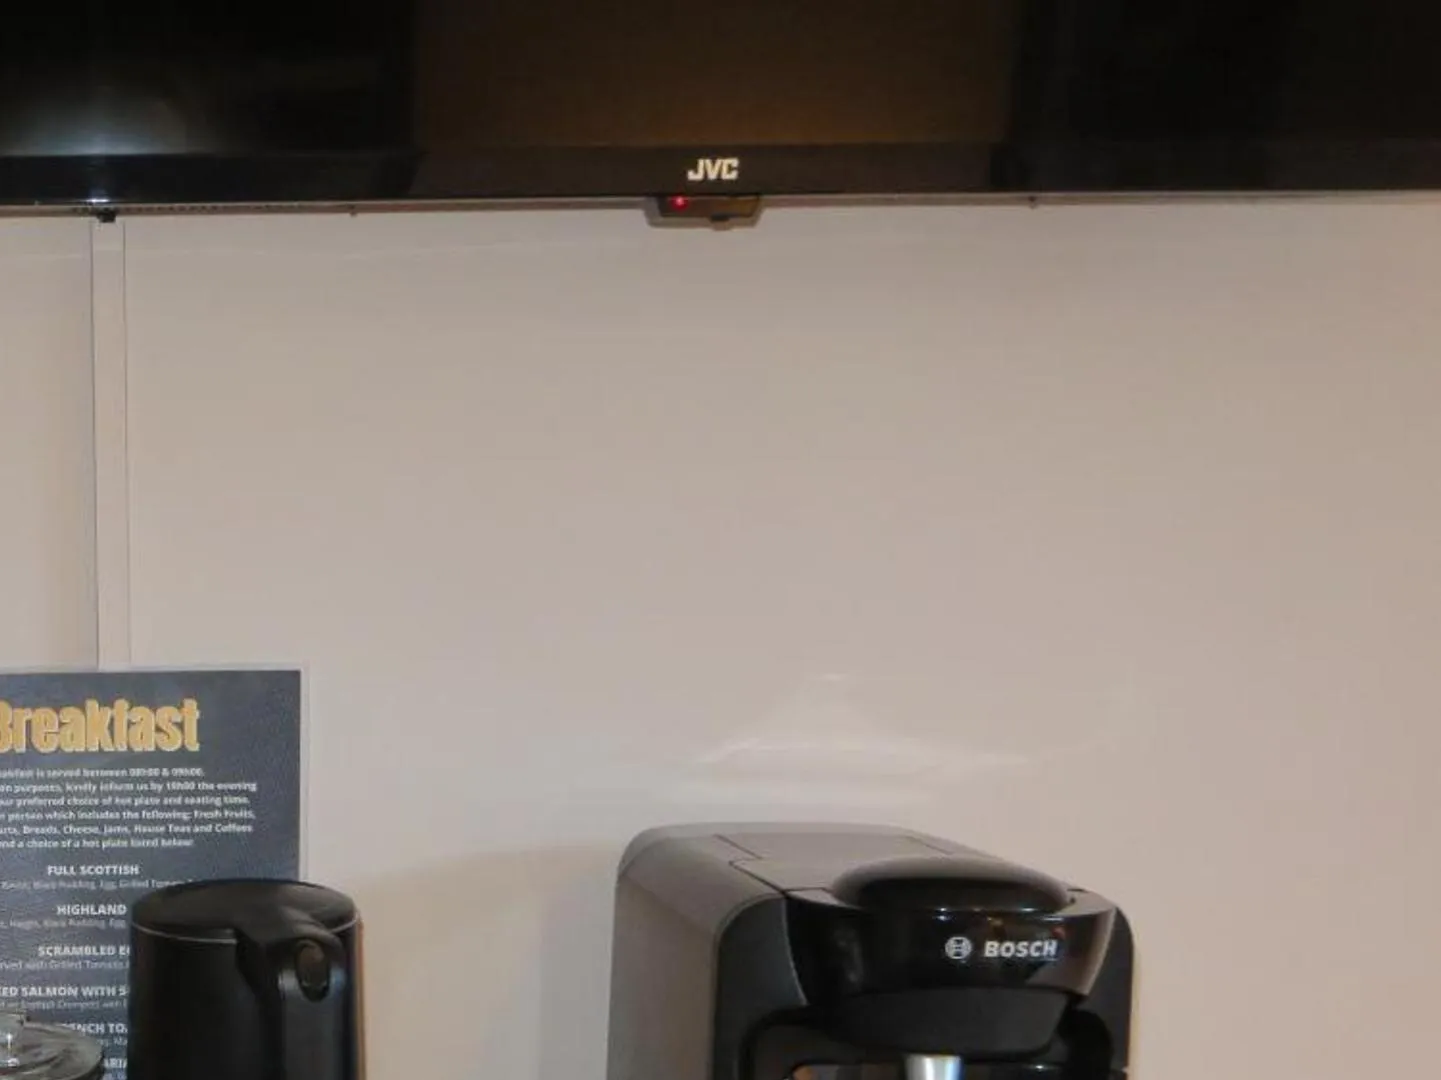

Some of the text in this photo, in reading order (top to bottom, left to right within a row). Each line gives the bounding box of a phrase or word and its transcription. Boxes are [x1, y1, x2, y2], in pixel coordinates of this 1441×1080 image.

[687, 157, 740, 181] JVC
[197, 781, 214, 790] the
[216, 782, 257, 792] evening
[162, 796, 182, 805] and
[122, 810, 139, 820] the
[193, 824, 212, 833] and
[26, 839, 59, 848] choice
[47, 863, 140, 876] FULL SCOTTISH
[56, 903, 128, 916] HIGHLAND
[38, 944, 114, 957] SCRAMBLED
[984, 939, 1058, 958] BOSCH
[22, 985, 79, 998] SALMON
[81, 985, 118, 997] WITH
